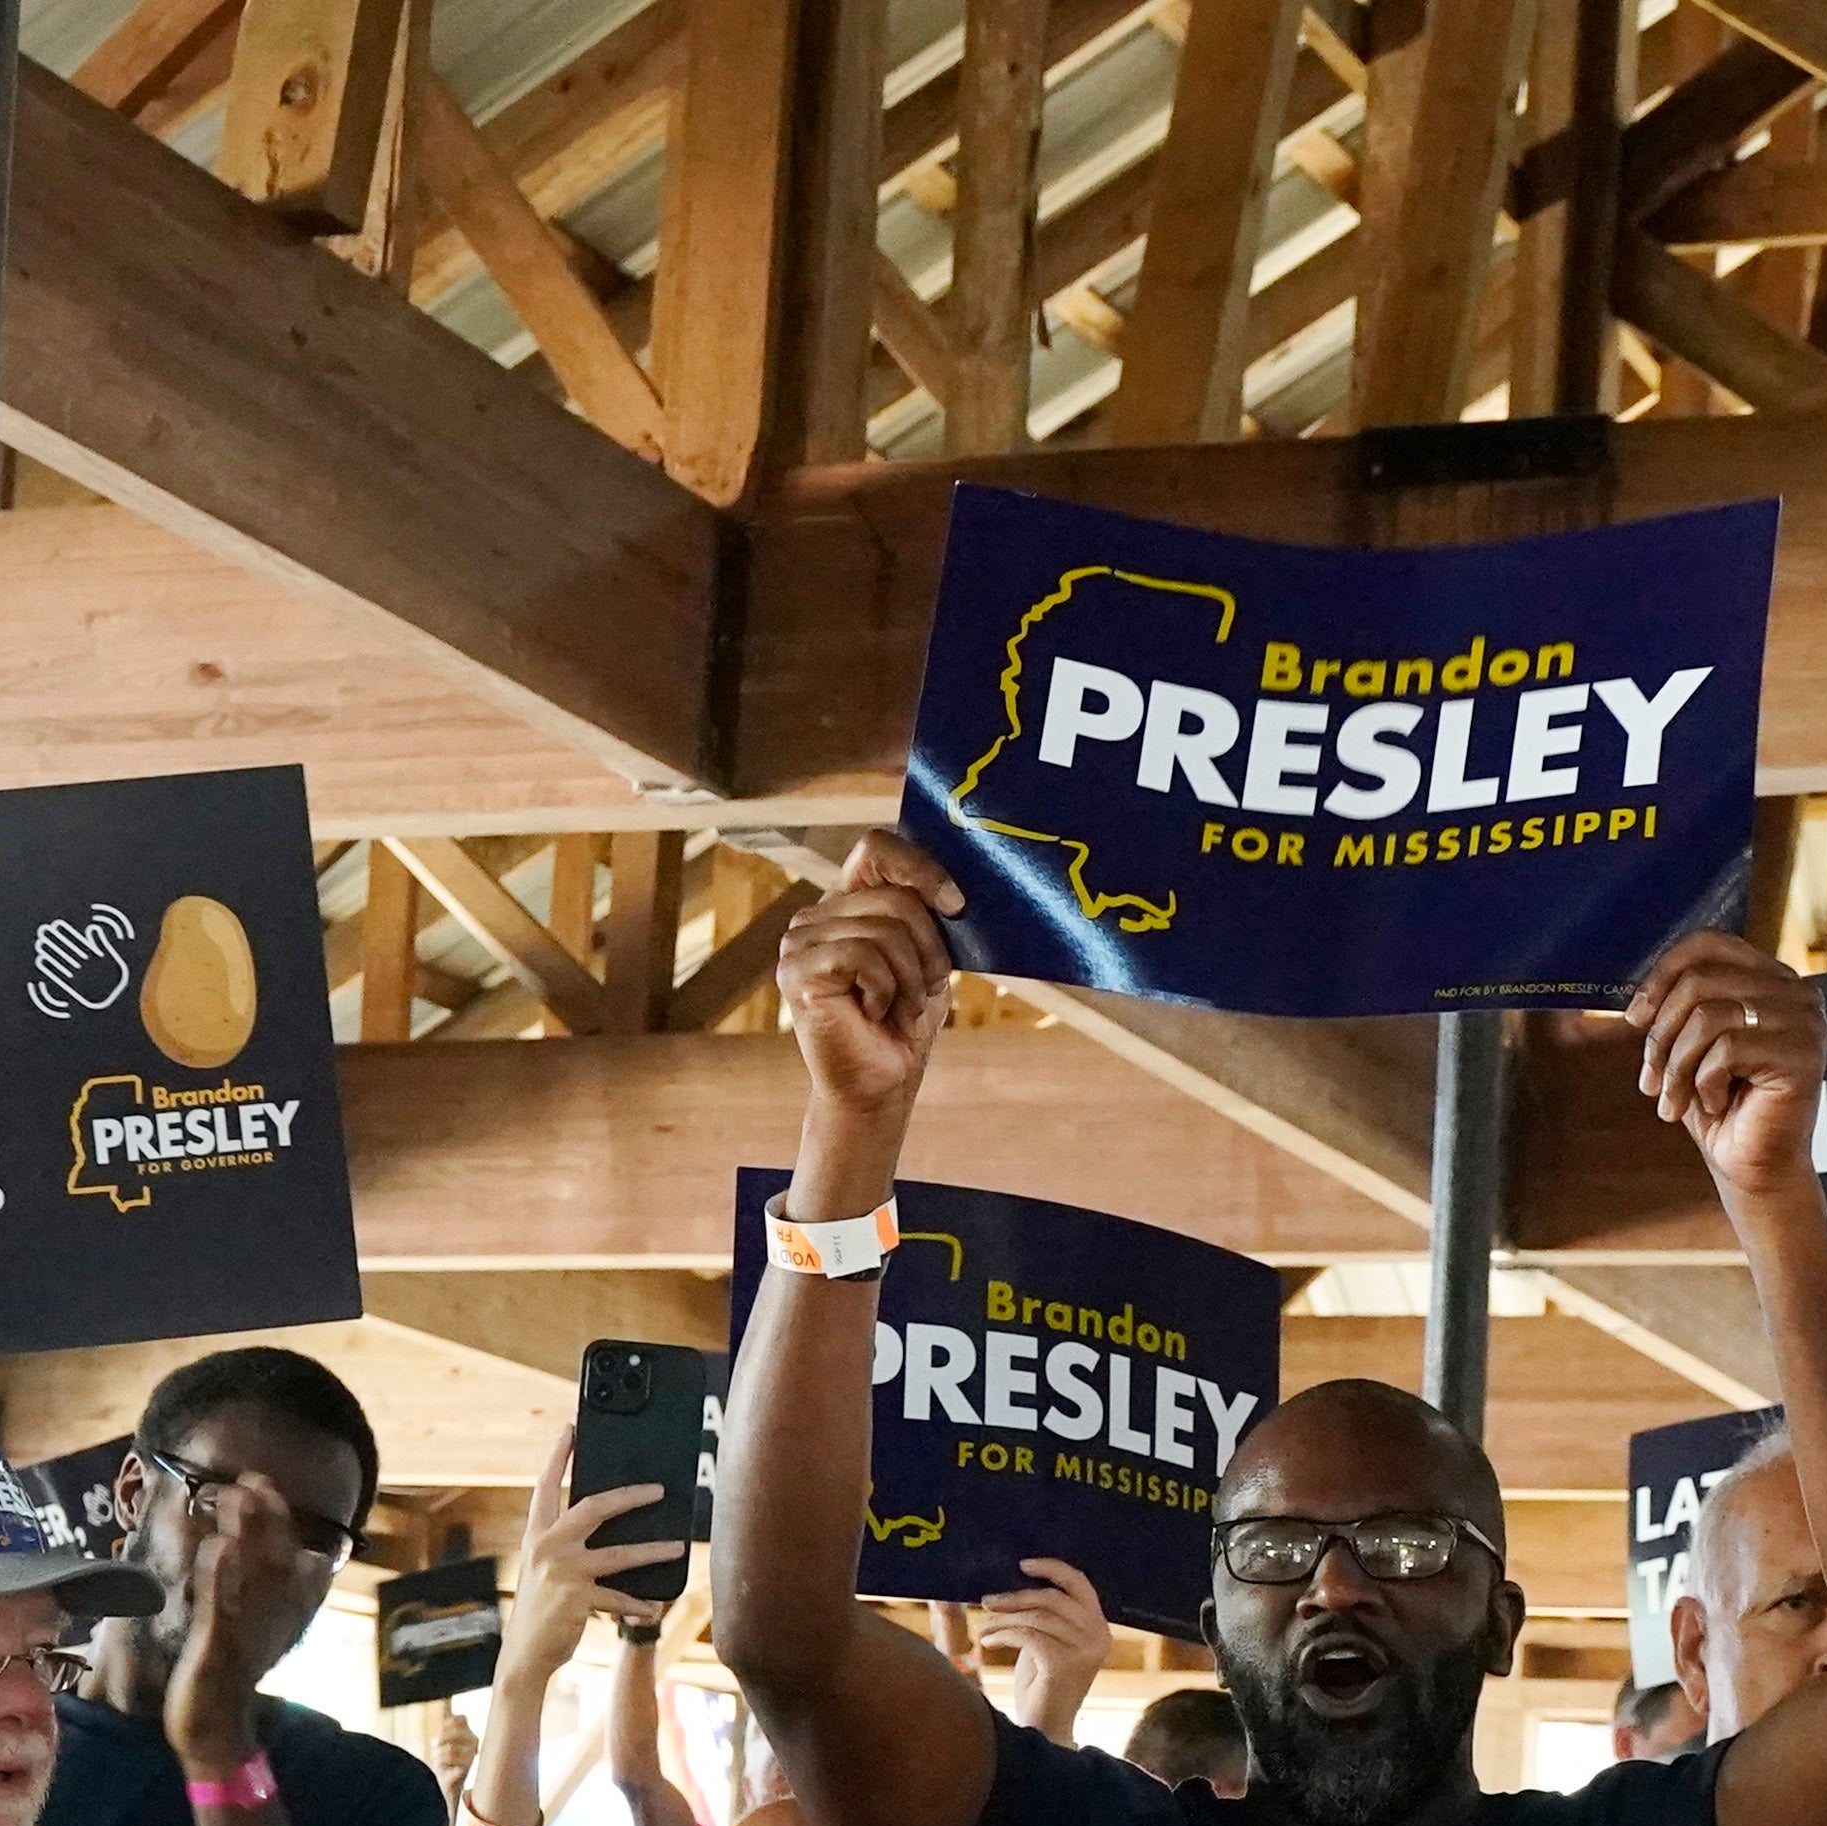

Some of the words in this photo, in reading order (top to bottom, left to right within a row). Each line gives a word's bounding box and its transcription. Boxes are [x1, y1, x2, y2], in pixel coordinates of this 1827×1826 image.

[1261, 634, 1576, 699] Brandon
[1037, 655, 1715, 820] PRESLEY
[1200, 822, 1305, 867] FOR
[1333, 806, 1660, 869] MISSISSIPPI
[1459, 986, 1481, 997] FOR
[1483, 986, 1497, 996] BY
[1499, 983, 1556, 995] BRANDON
[1557, 983, 1601, 994] PRESLEY
[1603, 984, 1635, 995] CAMP
[151, 1079, 265, 1110] Brandon
[91, 1100, 301, 1166] PRESLEY
[137, 1160, 173, 1176] FOR
[179, 1151, 275, 1173] GOVERNOR
[986, 1279, 1187, 1362] Brandon
[957, 1440, 1034, 1476] FOR
[1054, 1452, 1219, 1515] MISSISSIP
